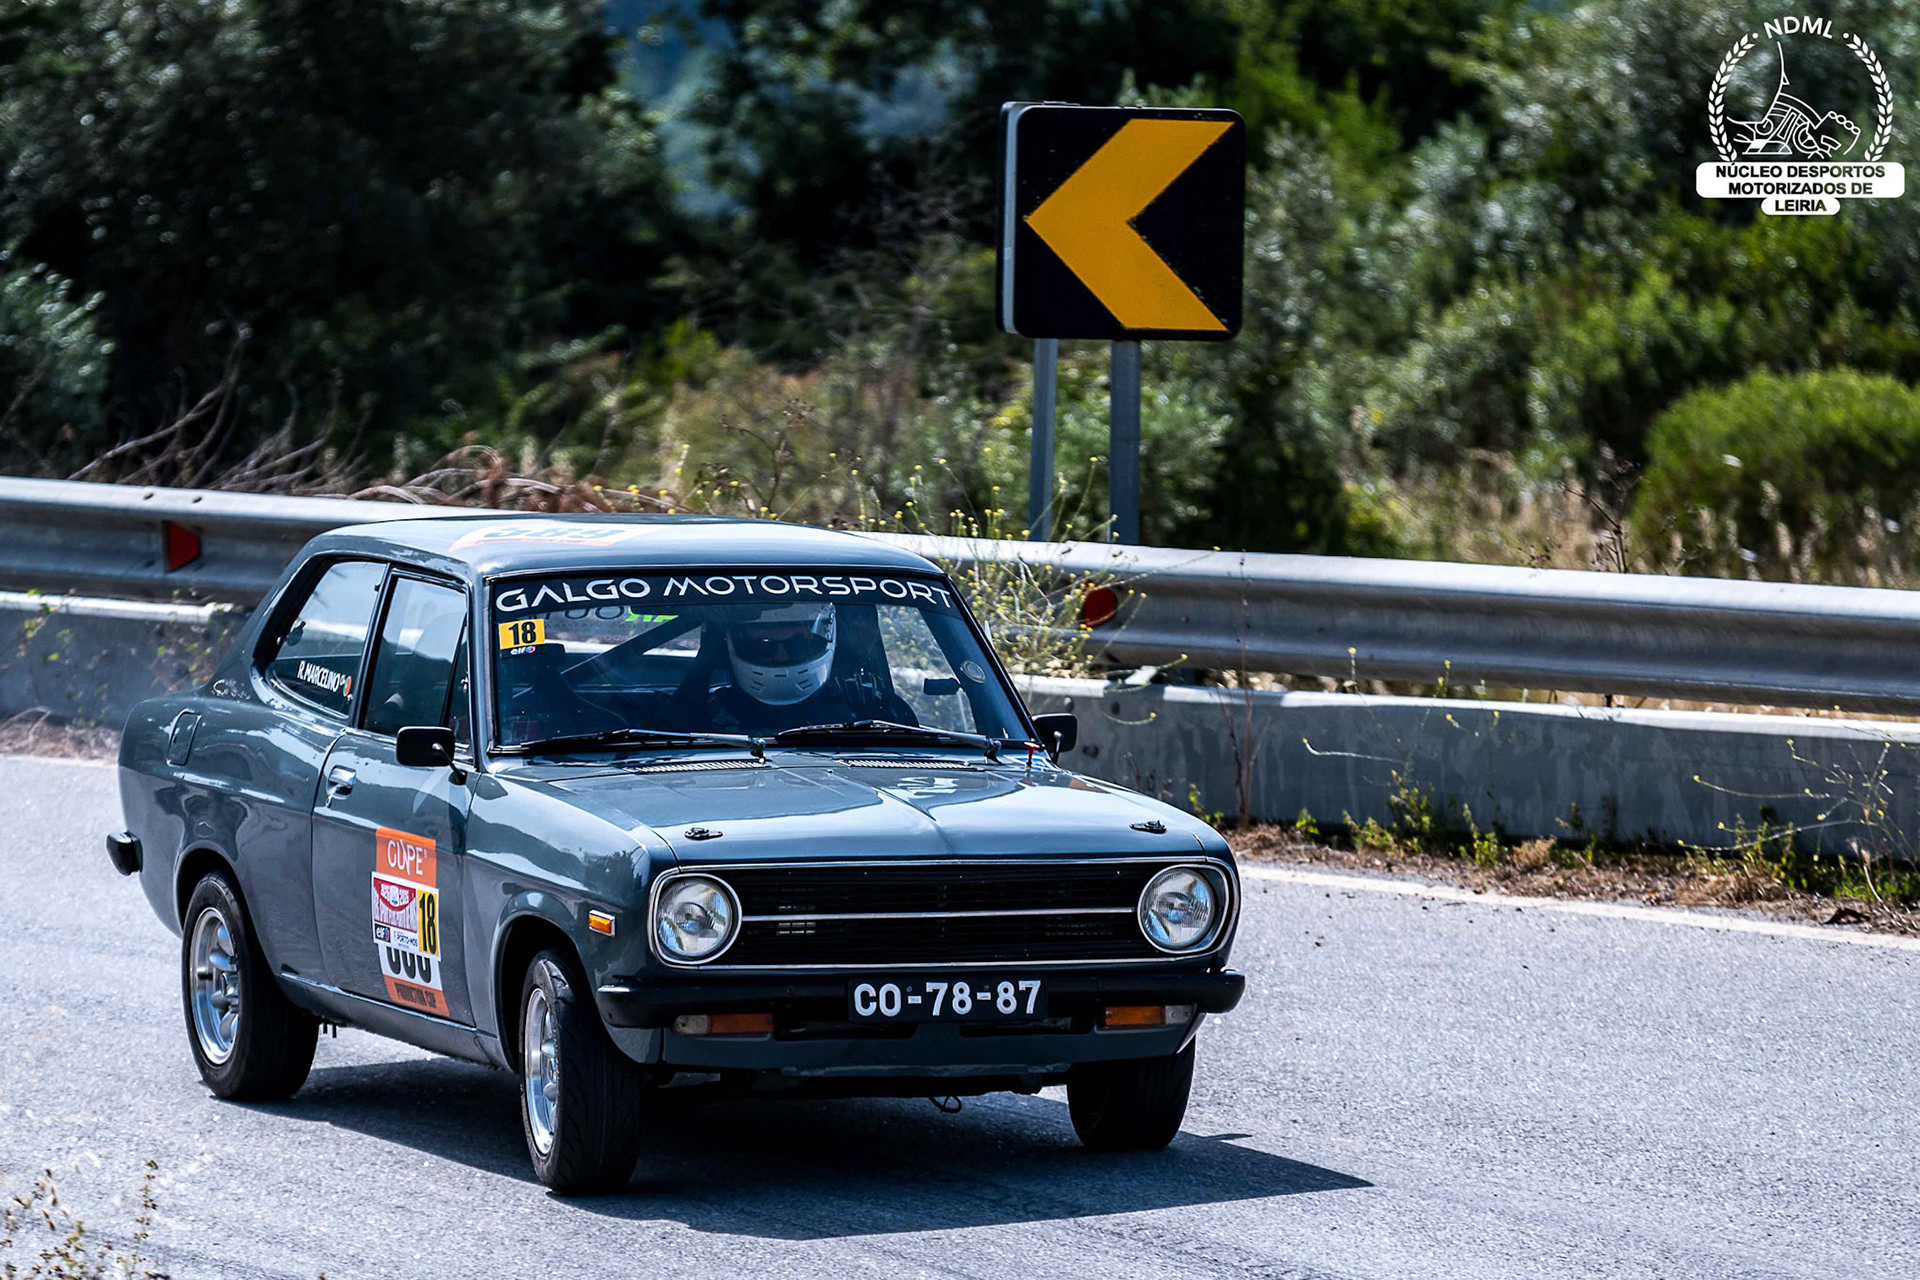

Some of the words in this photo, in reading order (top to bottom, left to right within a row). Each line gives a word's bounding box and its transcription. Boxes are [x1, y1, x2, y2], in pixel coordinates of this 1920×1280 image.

[496, 577, 651, 612] GALGO
[663, 575, 951, 608] MOTORSPORT
[508, 621, 537, 646] 18
[510, 646, 526, 655] elf
[419, 892, 437, 955] 18
[853, 980, 1042, 1017] CO-78-87
